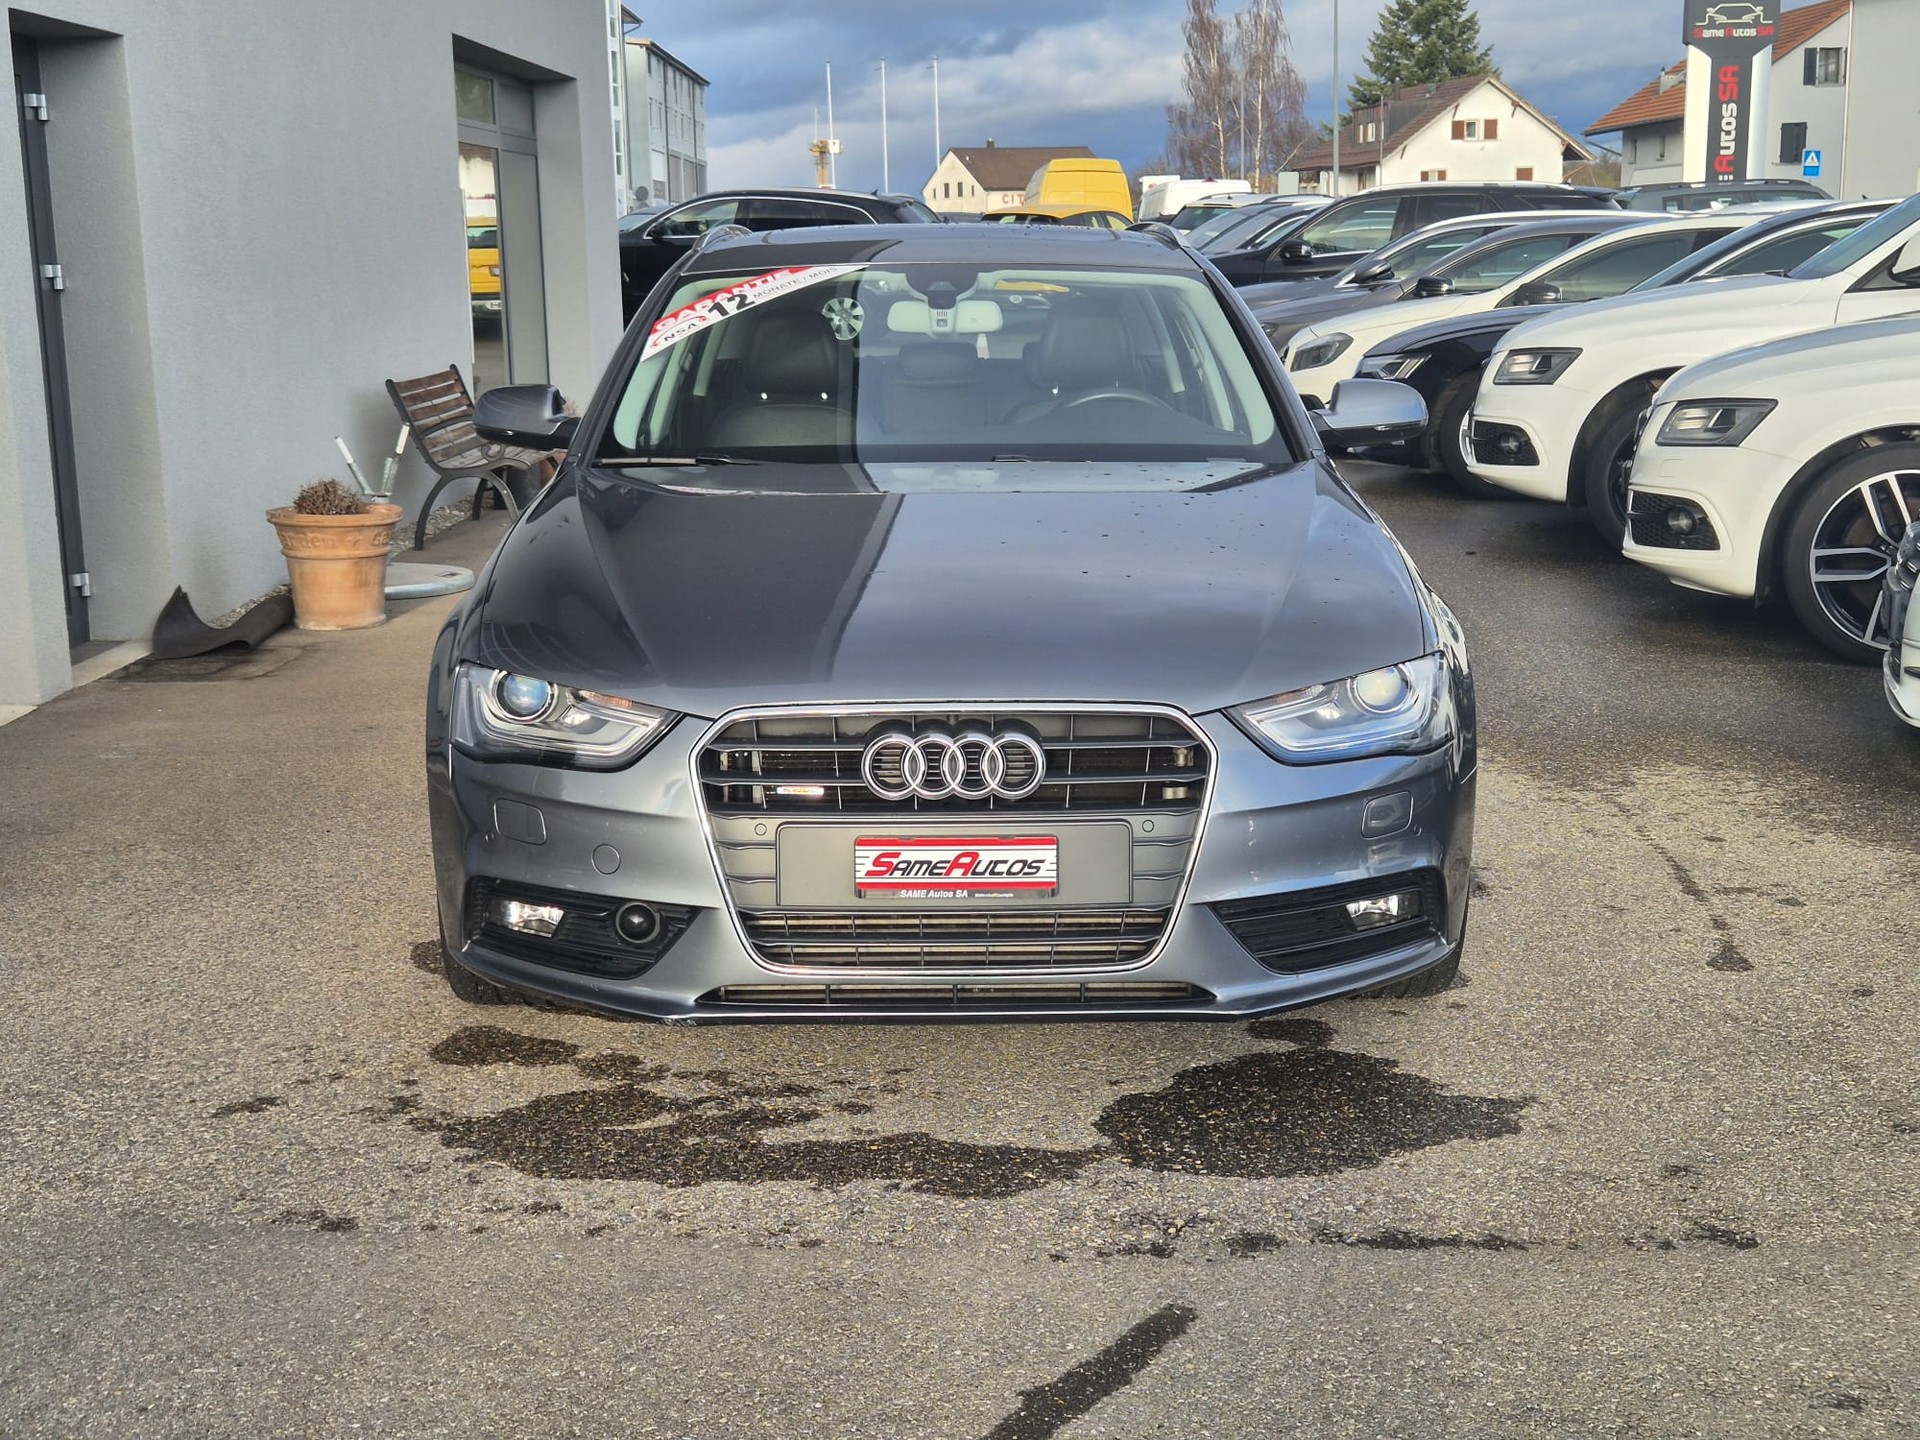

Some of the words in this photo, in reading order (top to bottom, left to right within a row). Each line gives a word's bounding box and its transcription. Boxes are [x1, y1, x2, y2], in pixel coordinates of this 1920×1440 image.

[707, 293, 756, 318] 12
[753, 280, 800, 298] MONATE
[808, 267, 838, 280] MOIS
[664, 322, 697, 342] NSA
[899, 889, 927, 898] SAME
[928, 889, 954, 898] Autos
[955, 889, 969, 898] SA
